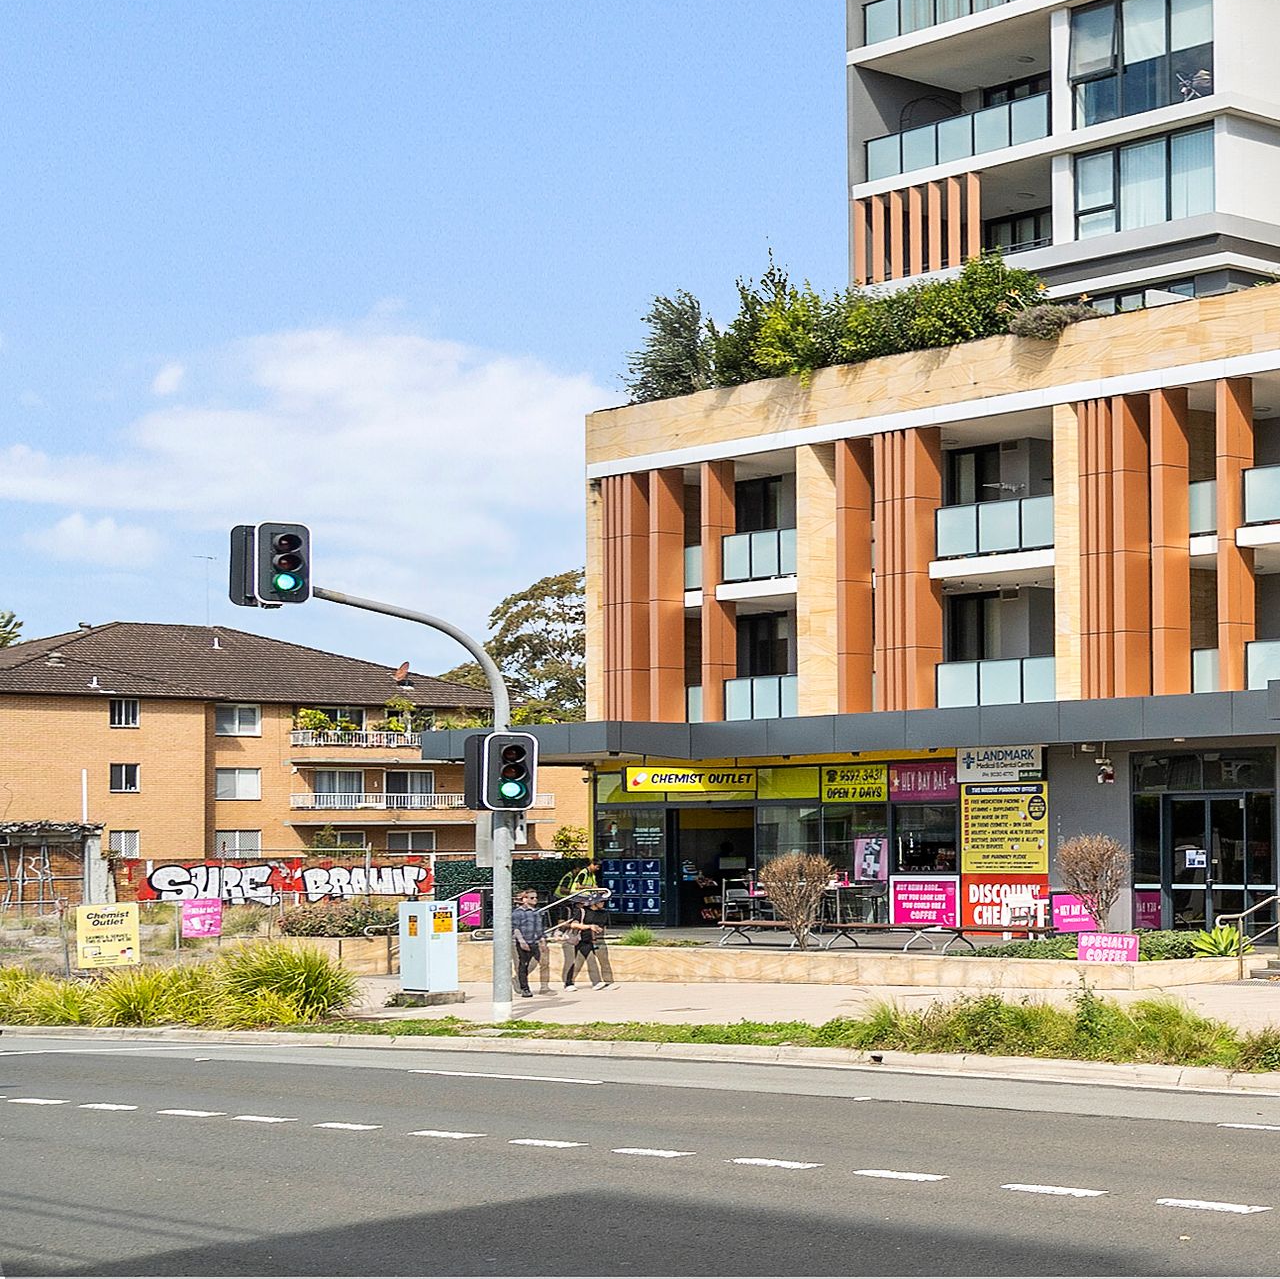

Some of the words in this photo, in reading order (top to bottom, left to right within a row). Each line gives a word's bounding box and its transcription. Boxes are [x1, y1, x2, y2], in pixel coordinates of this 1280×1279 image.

[976, 749, 1034, 762] LANDMARK
[651, 773, 705, 784] CHEMIST
[708, 773, 753, 784] OUTLET
[827, 787, 849, 799] OPEN
[851, 787, 858, 798] 7
[860, 786, 882, 798] DAYS
[86, 911, 129, 920] Chemist
[910, 911, 937, 920] COFFEE
[973, 905, 1036, 926] CHEIST
[92, 918, 124, 927] Outlet
[1080, 935, 1135, 949] SPECIALTY
[1086, 948, 1128, 961] COFFEE
